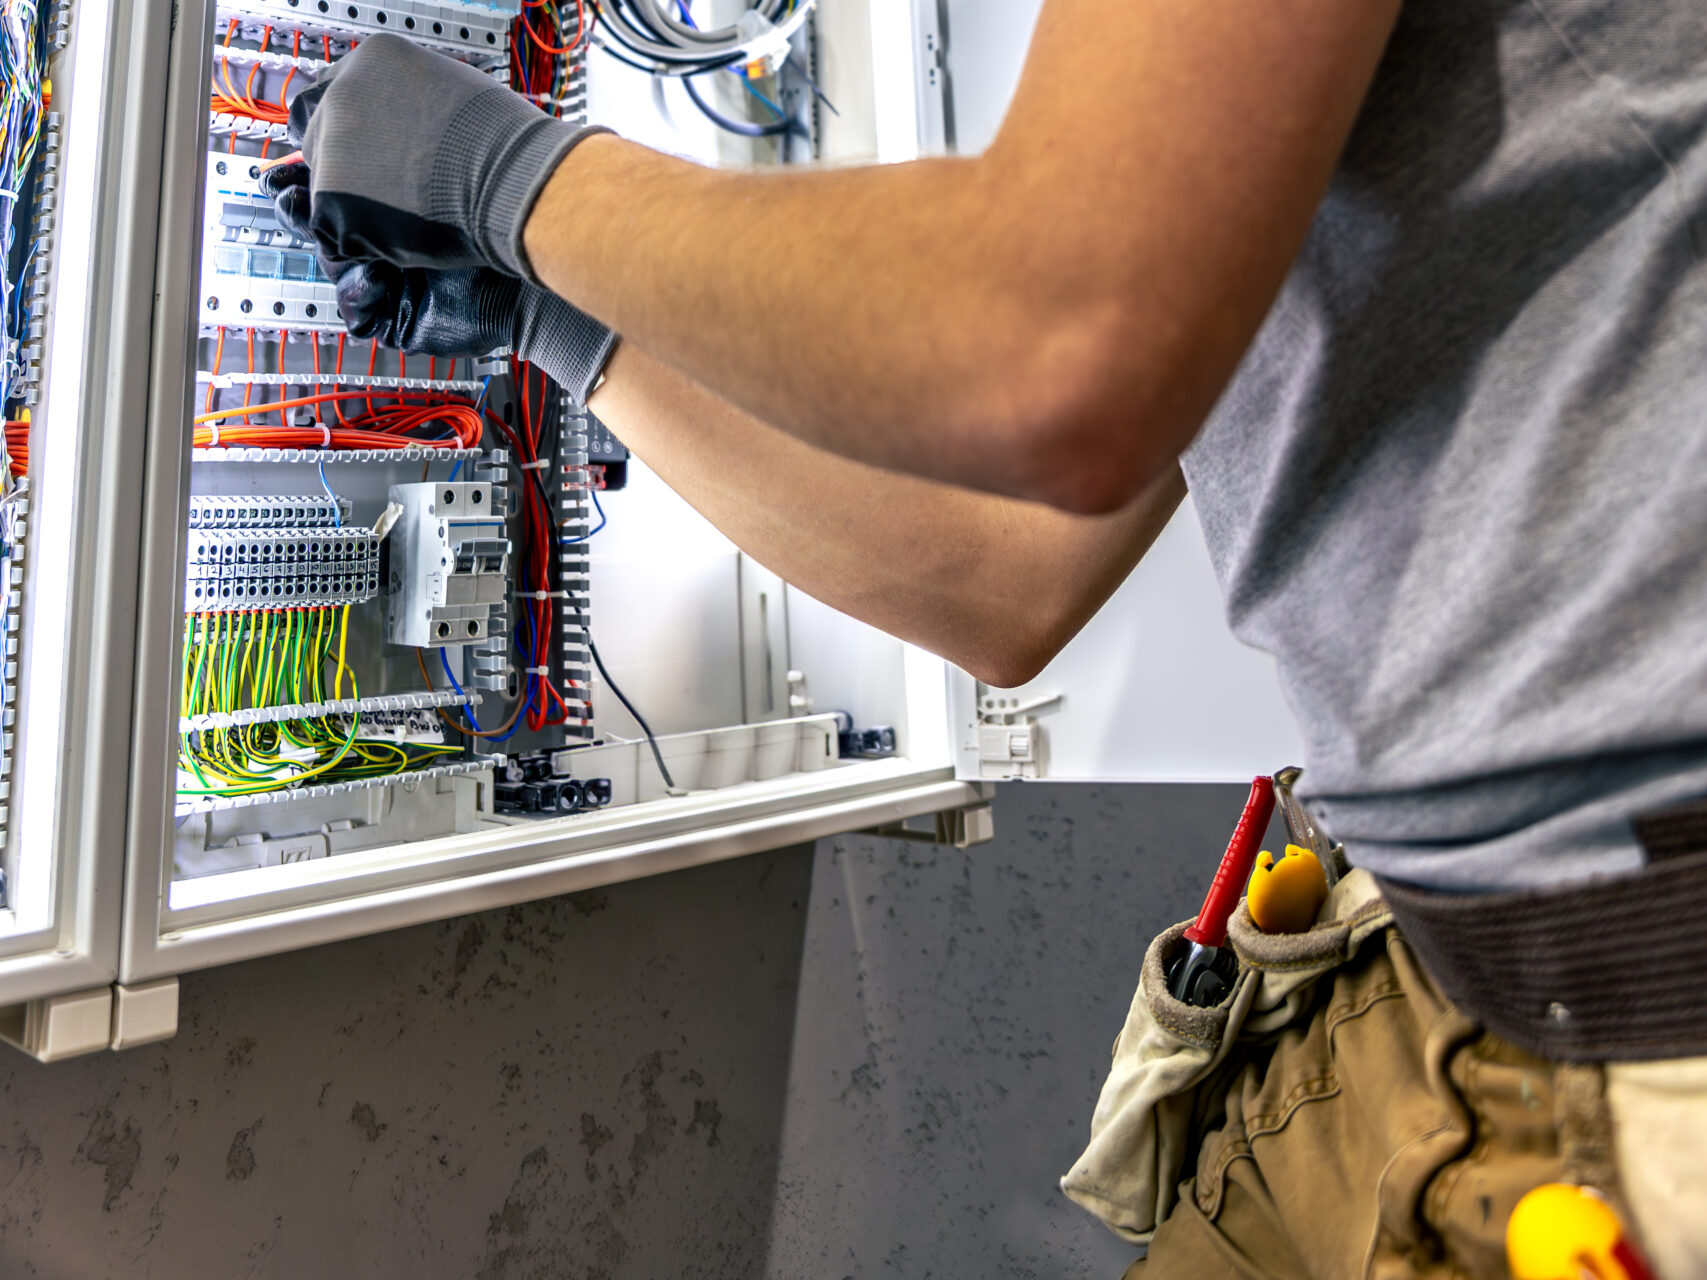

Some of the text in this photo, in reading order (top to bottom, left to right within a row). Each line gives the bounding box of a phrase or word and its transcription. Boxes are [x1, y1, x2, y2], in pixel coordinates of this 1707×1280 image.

[197, 566, 202, 575] 1
[211, 566, 218, 574] 2
[226, 566, 233, 575] 3
[239, 565, 245, 573] 4
[251, 565, 259, 573] 5
[276, 565, 282, 573] 7
[287, 565, 293, 573] 8
[299, 564, 305, 573] 9
[311, 564, 319, 572] 10
[347, 563, 354, 571] 13
[370, 561, 378, 569] 15
